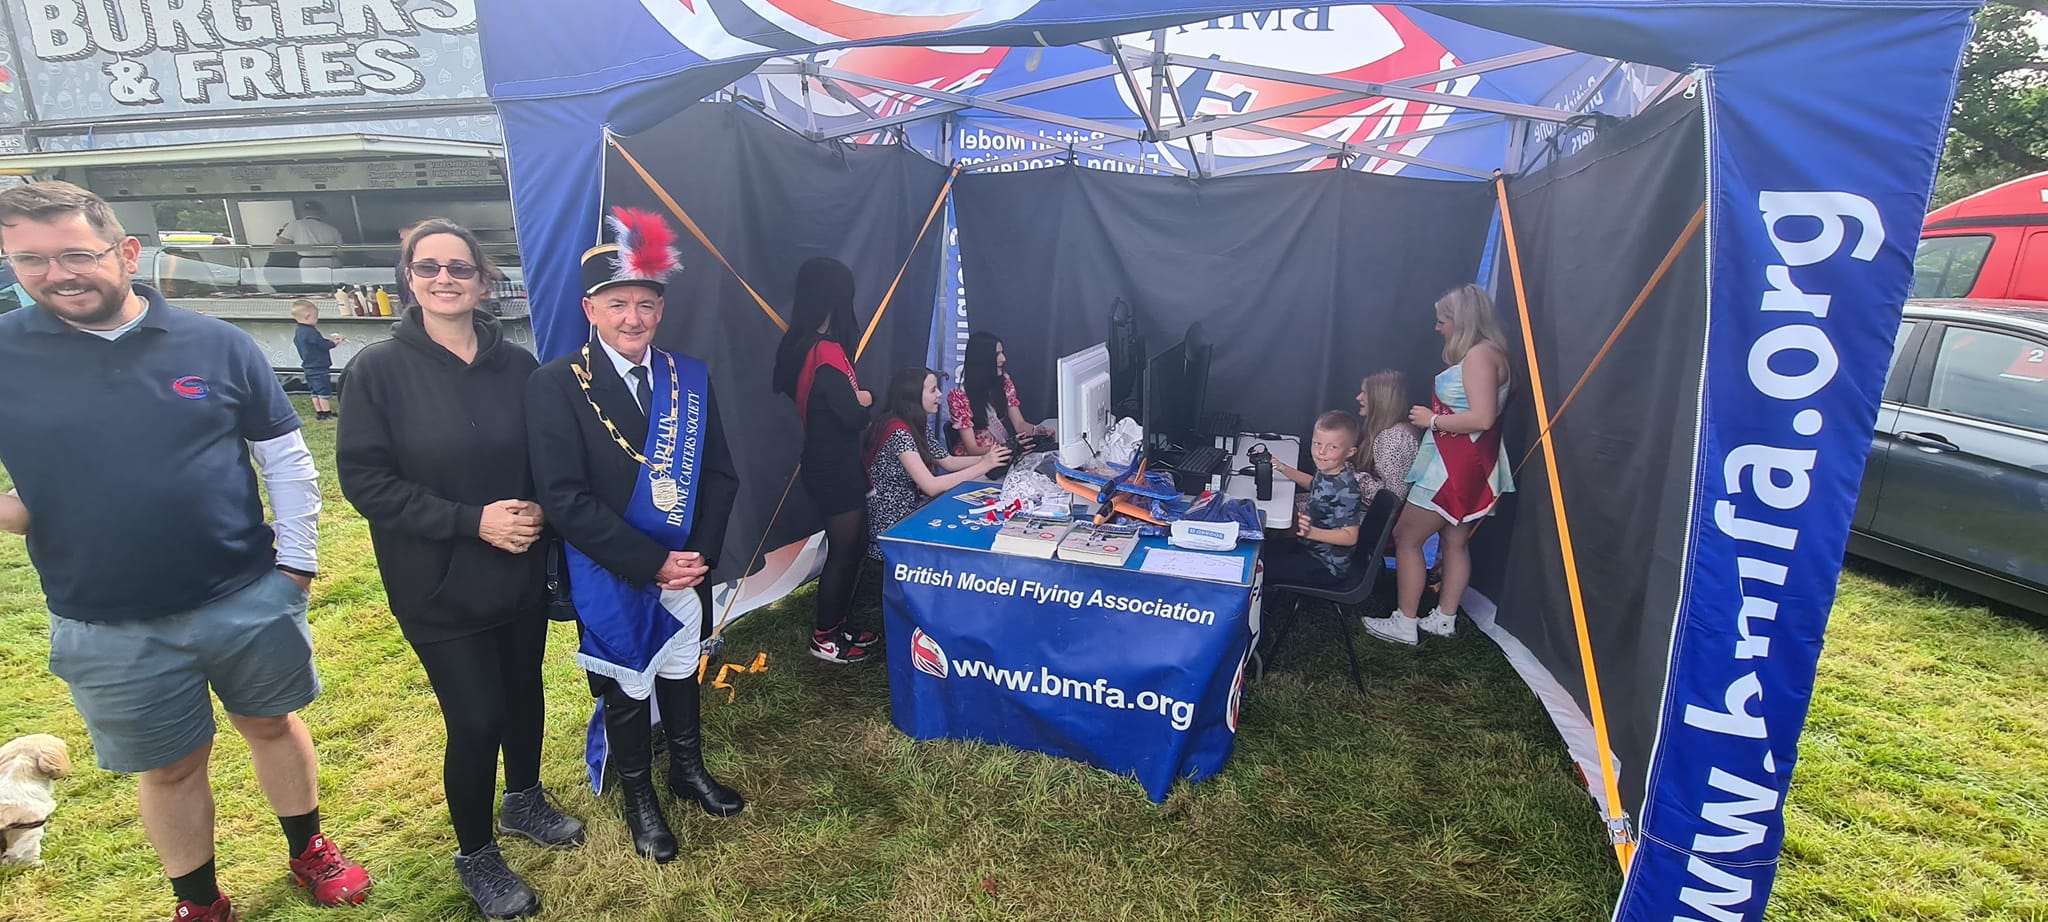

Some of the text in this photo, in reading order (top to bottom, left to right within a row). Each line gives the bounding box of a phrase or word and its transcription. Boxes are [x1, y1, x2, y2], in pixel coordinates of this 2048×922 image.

[102, 39, 425, 105] & FRIES
[686, 390, 700, 436] SOCIETY
[681, 437, 697, 485] CARTERS
[895, 563, 1216, 626] British Model Flying Association
[952, 657, 1195, 732] www.bmfa.org
